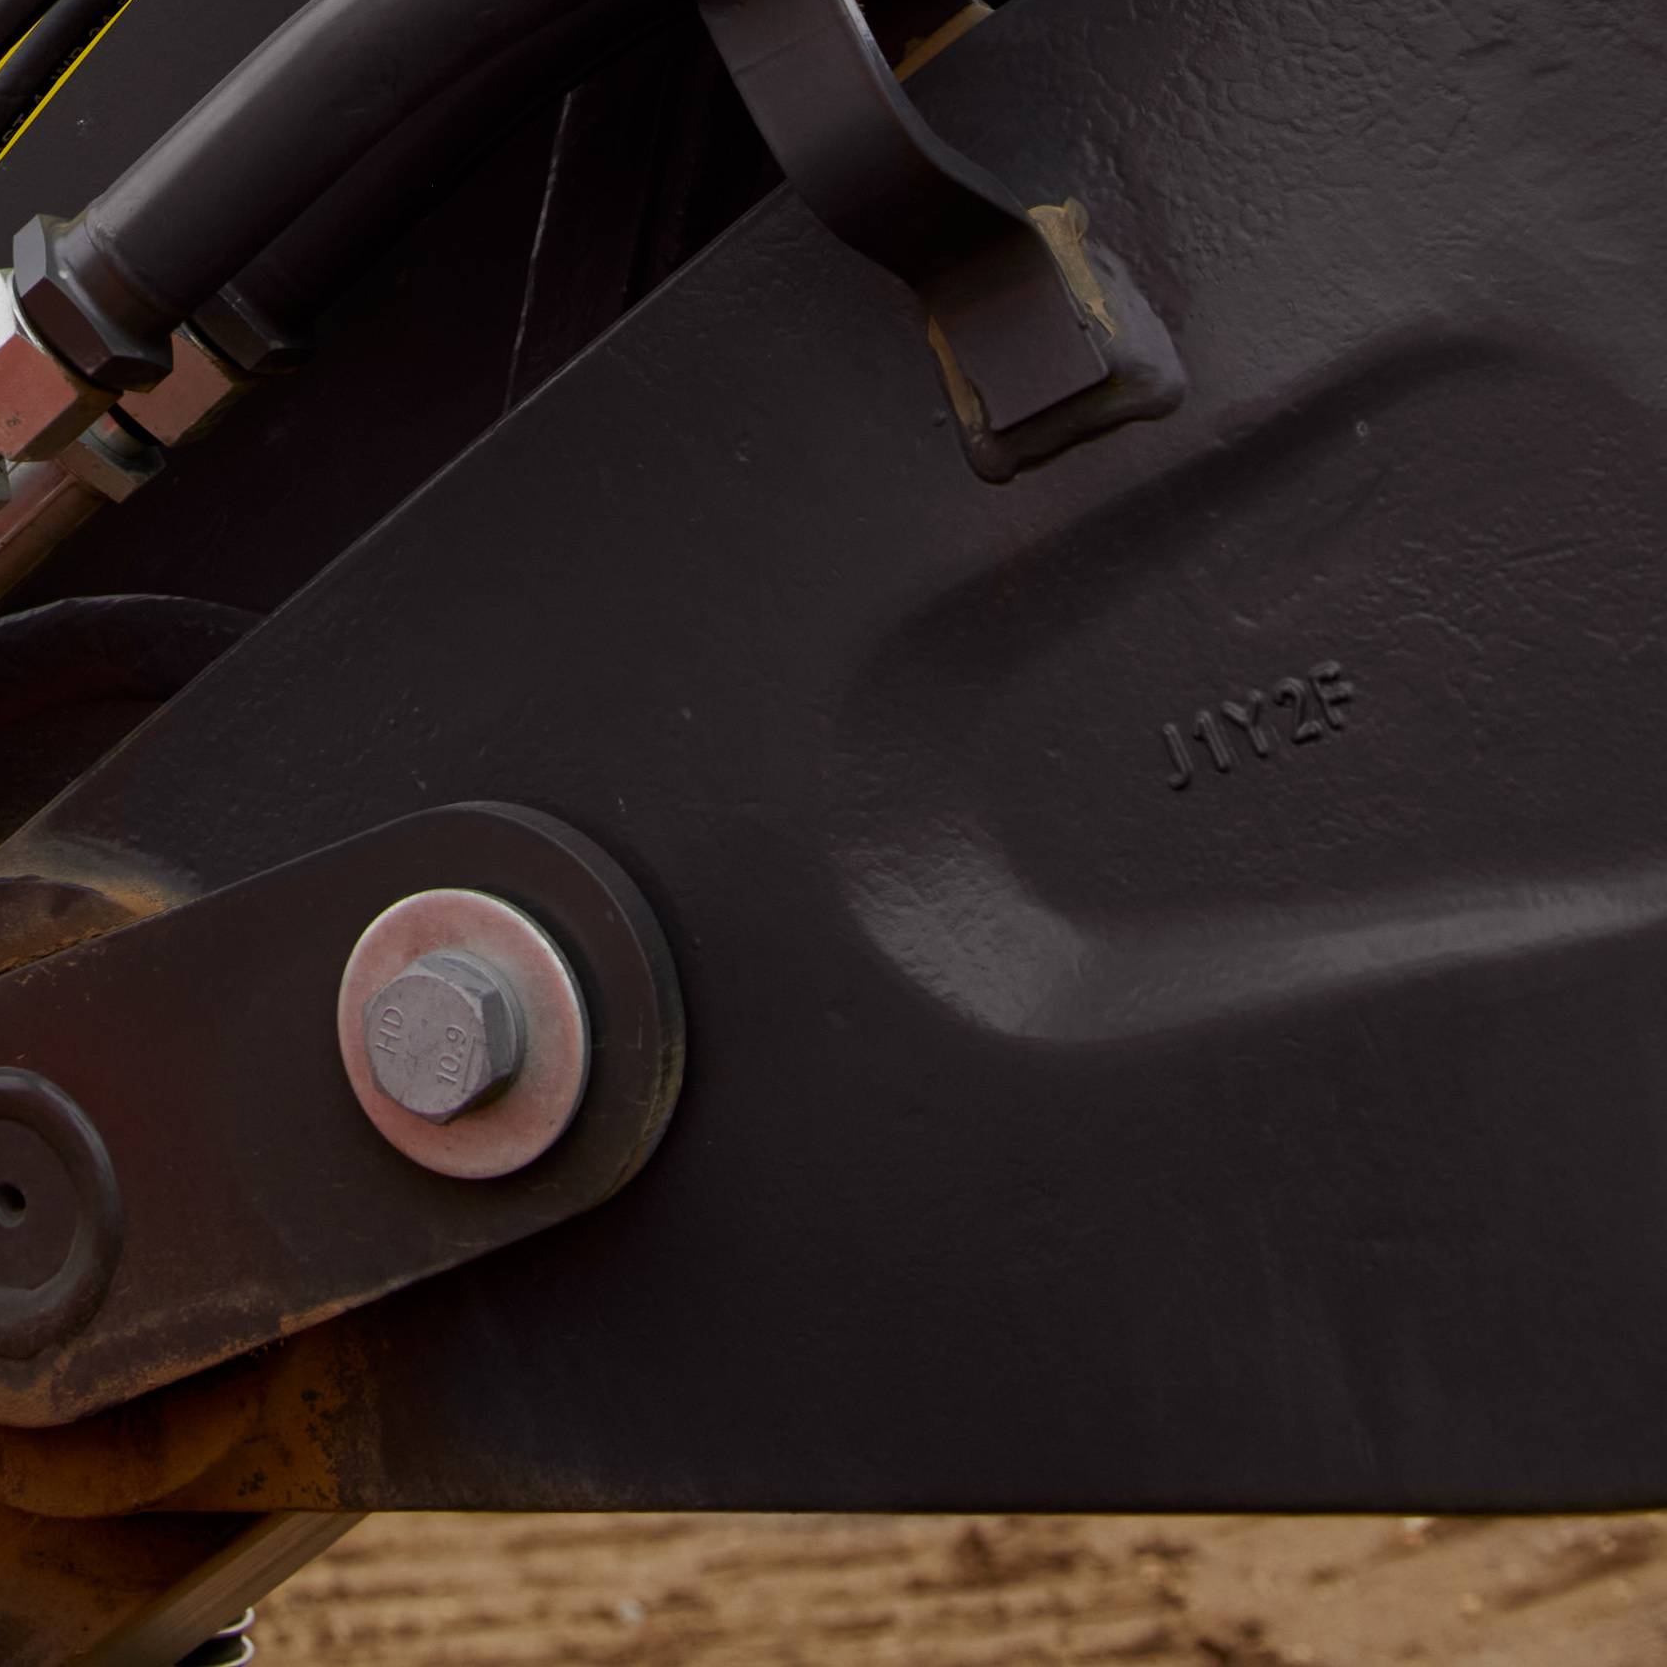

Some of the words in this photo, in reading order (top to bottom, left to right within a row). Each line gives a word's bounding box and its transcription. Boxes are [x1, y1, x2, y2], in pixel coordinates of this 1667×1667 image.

[1160, 659, 1358, 792] J1Y2F
[375, 1005, 406, 1057] HD
[436, 1026, 468, 1088] 10.9
